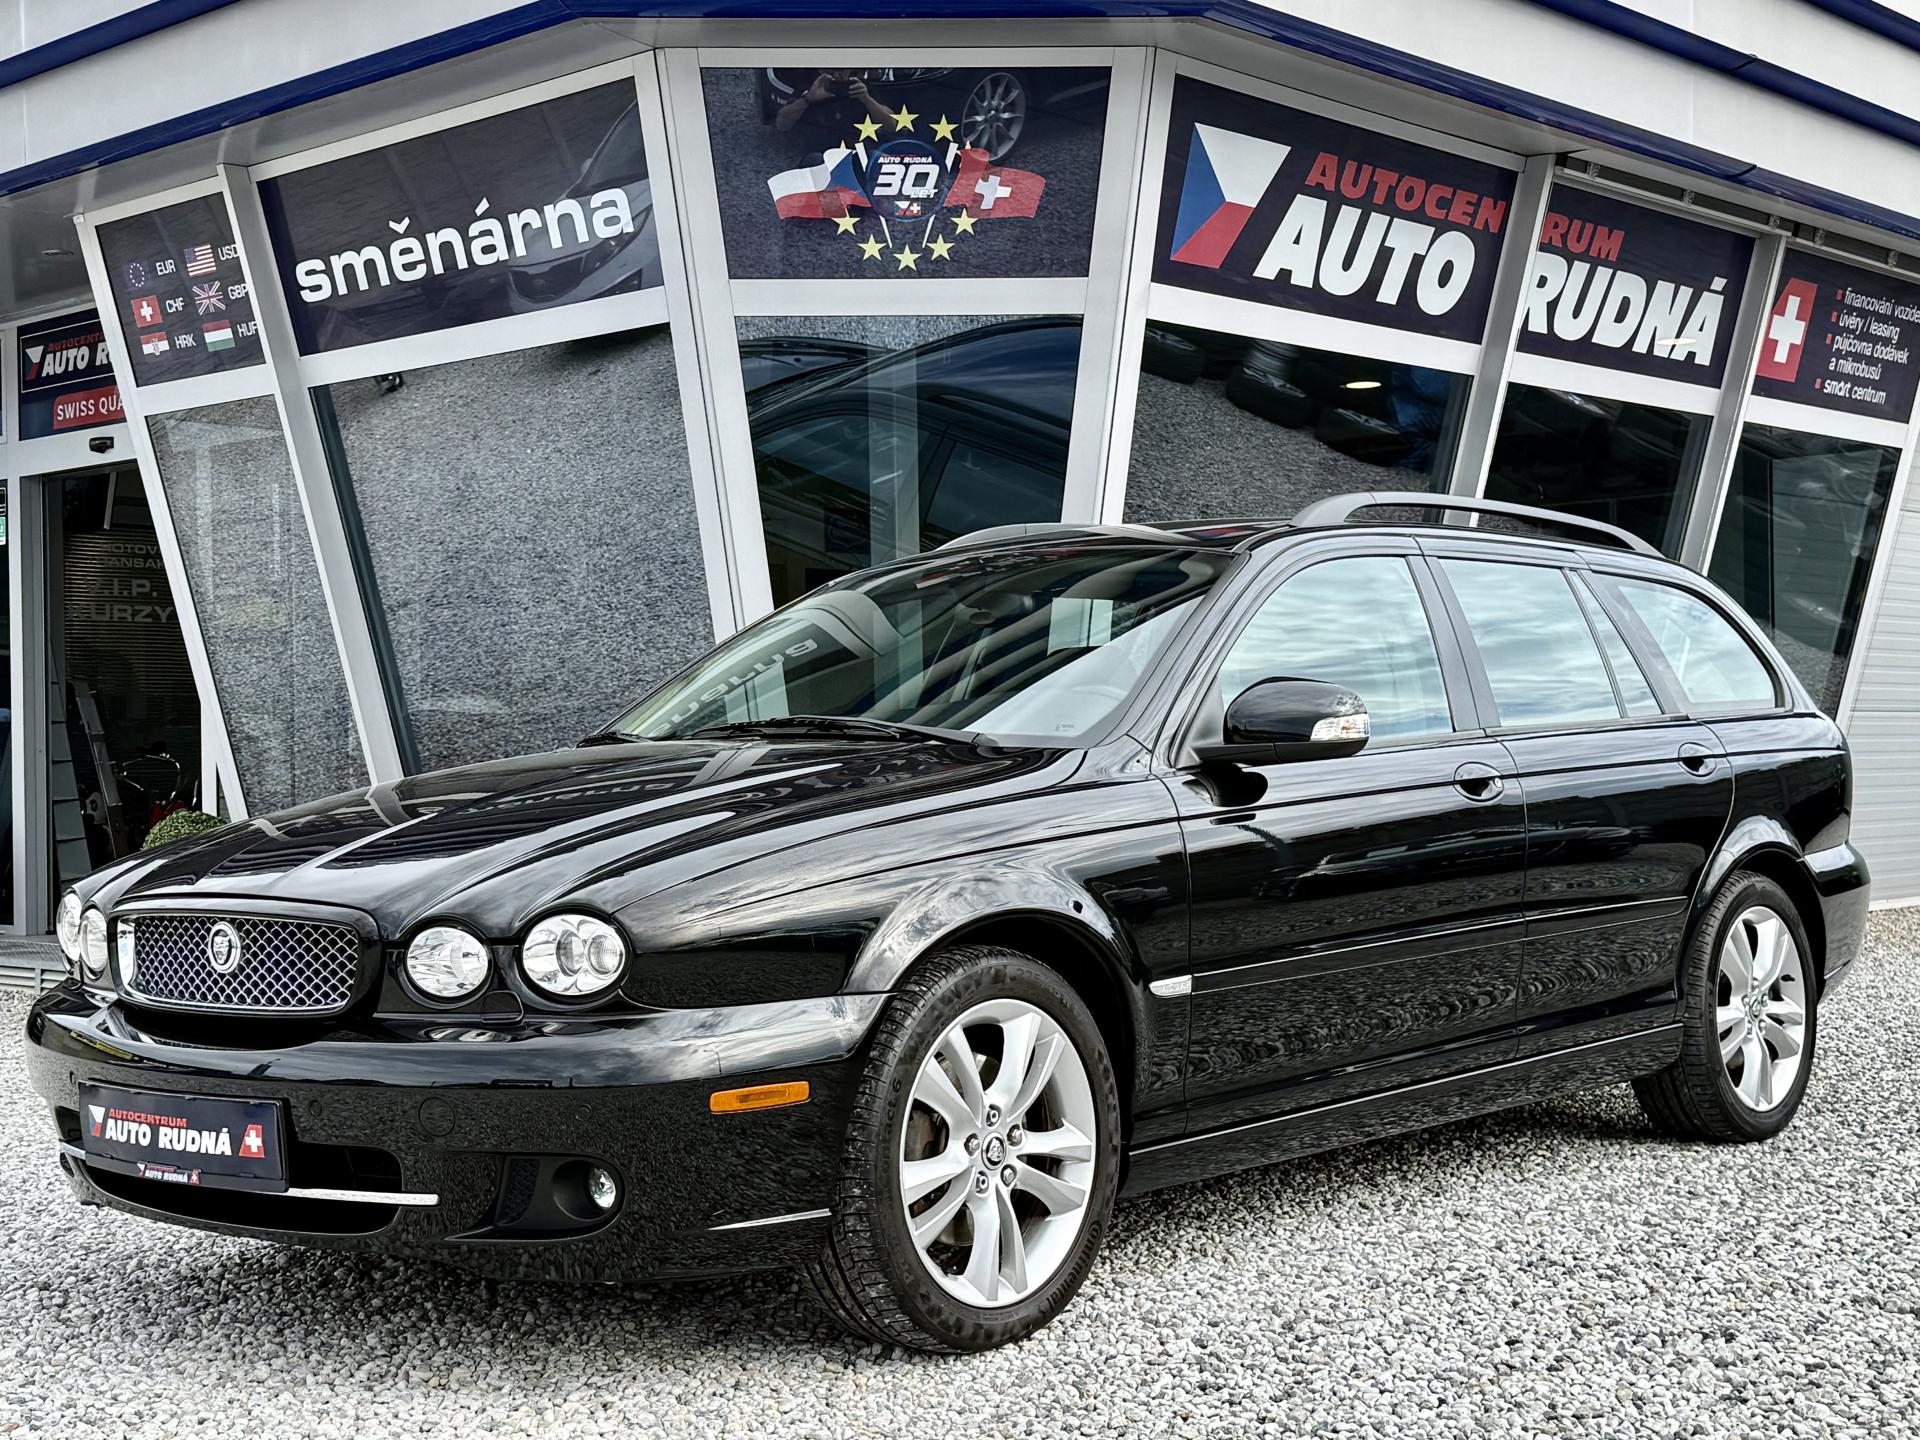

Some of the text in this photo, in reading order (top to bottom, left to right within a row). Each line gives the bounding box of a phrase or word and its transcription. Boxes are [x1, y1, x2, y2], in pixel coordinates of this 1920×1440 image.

[872, 164, 940, 196] 30
[910, 188, 939, 199] LET
[1305, 152, 1505, 234] AUTOCEN
[218, 244, 240, 261] USD
[295, 187, 635, 303] směnárna
[155, 259, 176, 276] EUR
[1253, 193, 1728, 366] AUTO RUDNÁ
[228, 284, 249, 300] GBP
[165, 297, 184, 313] CHF
[1844, 287, 1920, 323] financování vozide
[1839, 309, 1864, 335] úvěry
[1869, 316, 1900, 344] leasing
[174, 333, 196, 350] HRK
[1832, 333, 1910, 364] půjčovna dodávek
[41, 345, 89, 378] AUTO
[1828, 356, 1882, 381] a mikrobusů
[1823, 379, 1886, 405] smart centrum
[57, 399, 95, 421] SWISS
[108, 1108, 188, 1128] AUTOCENTRUM
[105, 1118, 232, 1156] AUTO RUDNÁ
[144, 1169, 188, 1183] AUTO RUDNÁ
